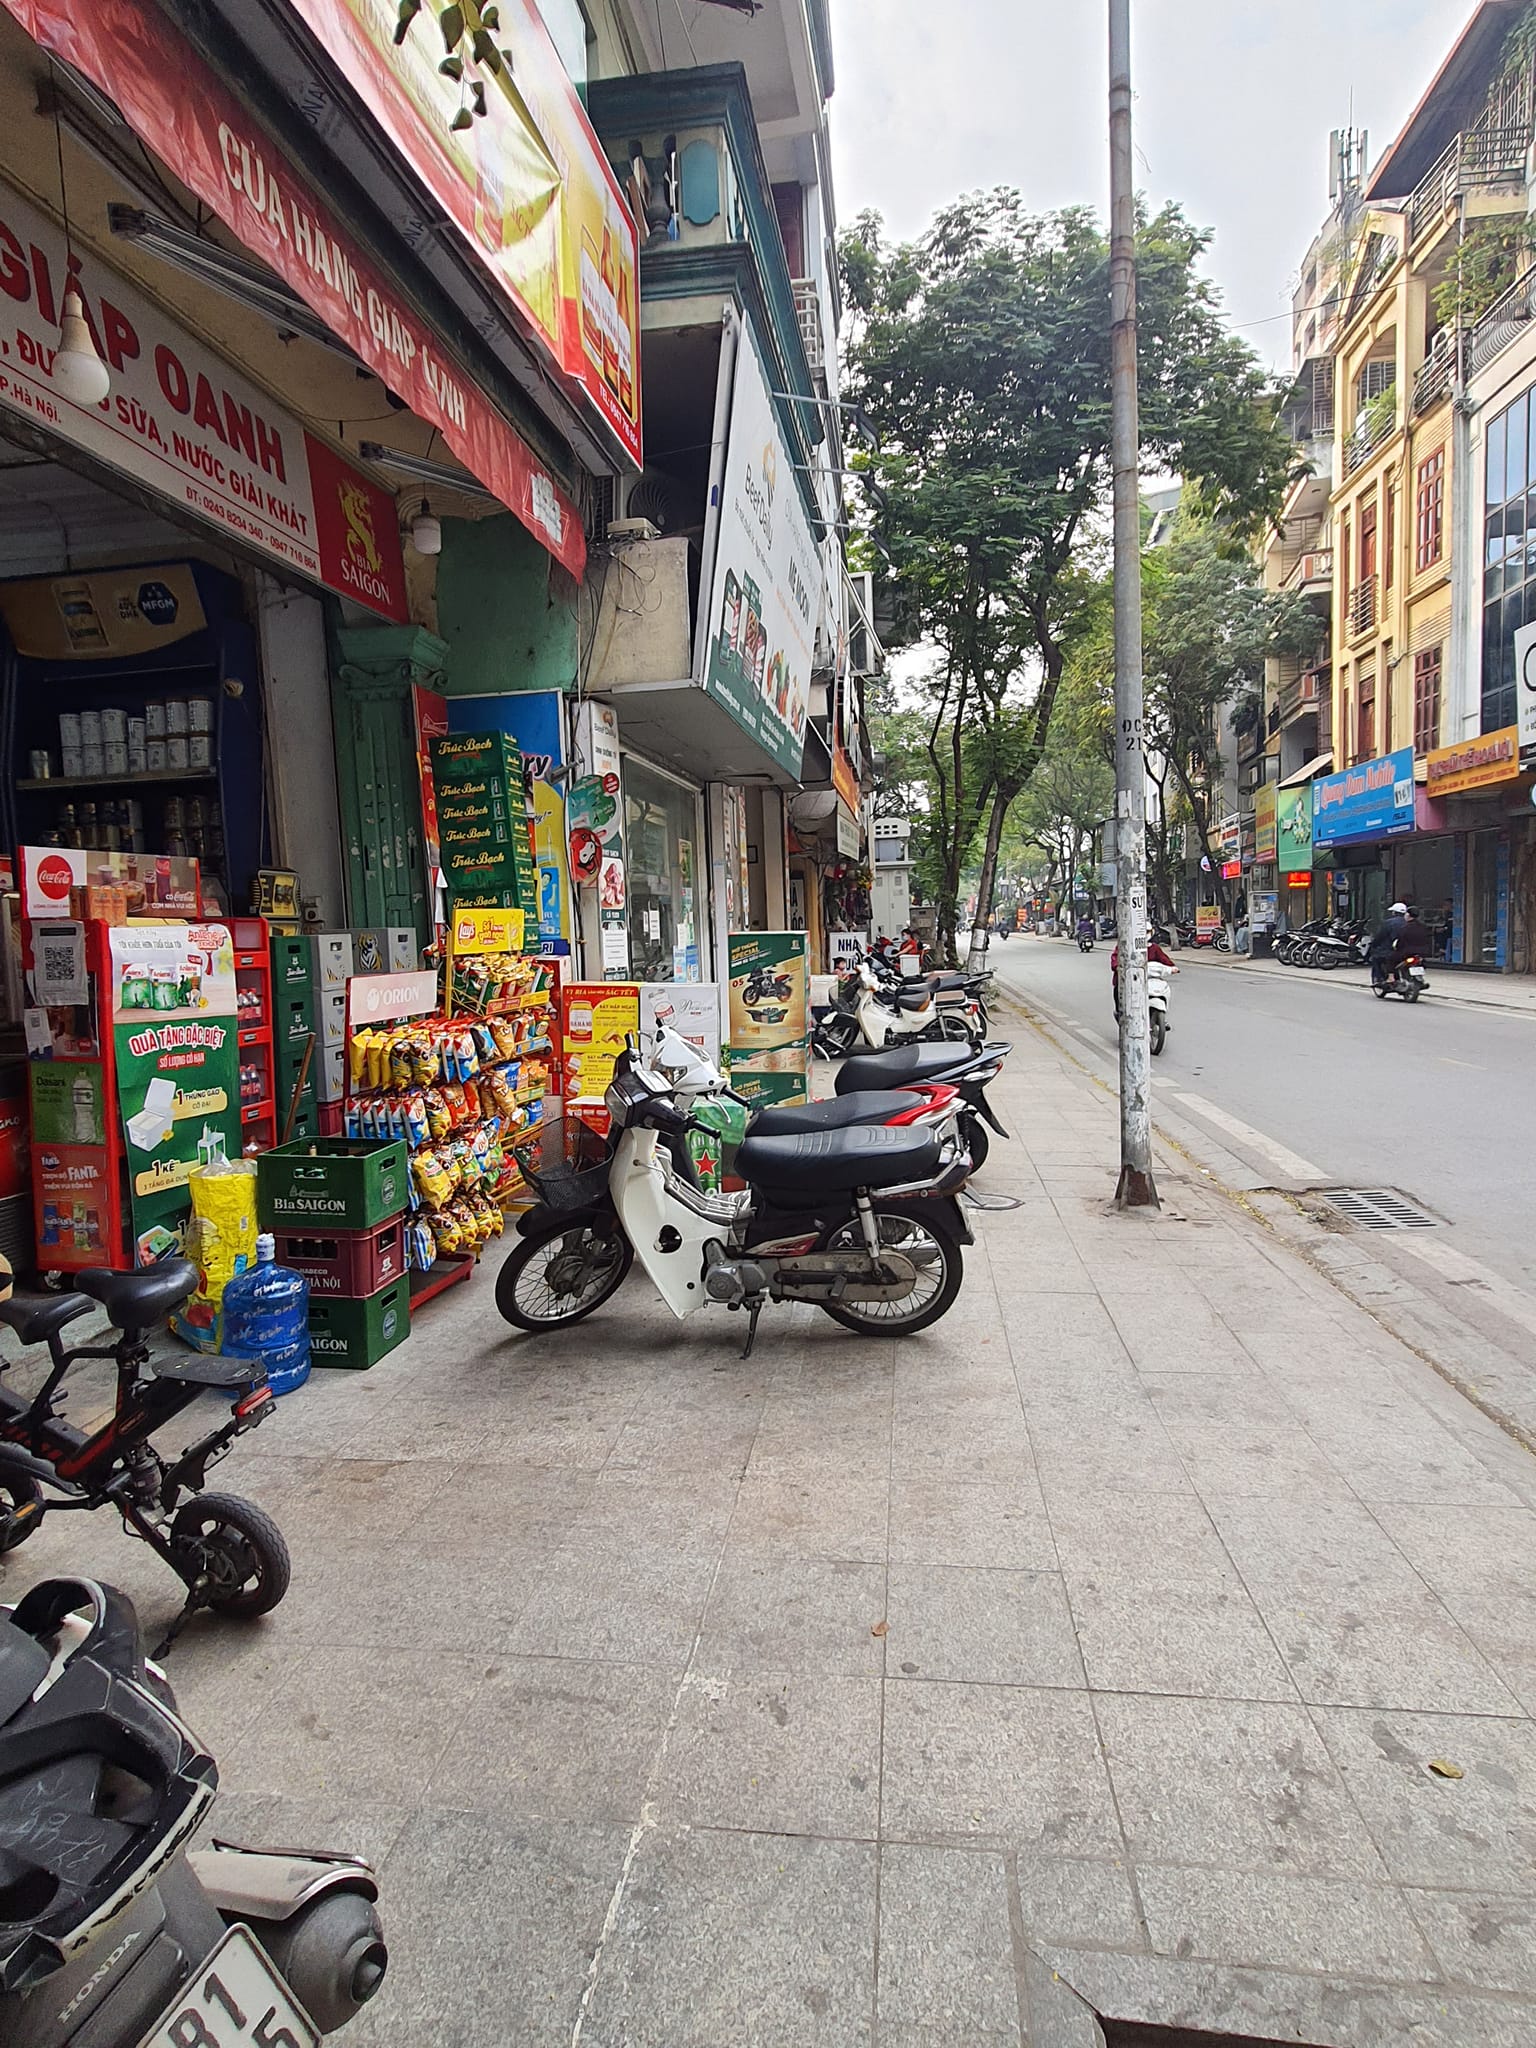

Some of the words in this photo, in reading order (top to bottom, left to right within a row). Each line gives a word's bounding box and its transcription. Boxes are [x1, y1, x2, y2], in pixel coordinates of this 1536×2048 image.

[290, 199, 363, 322] HÀNG
[366, 288, 416, 370] GIÁP
[154, 343, 287, 485] OANH
[172, 430, 226, 485] NƯỚC
[266, 491, 307, 536] KHÁT
[340, 557, 391, 605] SAIGON
[142, 598, 175, 611] MFGM
[38, 869, 72, 884] Coca-Cola
[382, 988, 421, 1006] ORION
[129, 1028, 158, 1055] QUÀ
[158, 1025, 185, 1051] TẶNG
[186, 1023, 204, 1048] ĐẶC
[204, 1025, 225, 1050] BIỆT
[176, 1090, 183, 1106] 1
[153, 1161, 160, 1177] 1
[297, 1199, 346, 1212] SAIGON
[322, 1275, 341, 1290] NỘI
[57, 1930, 142, 2024] HONDA
